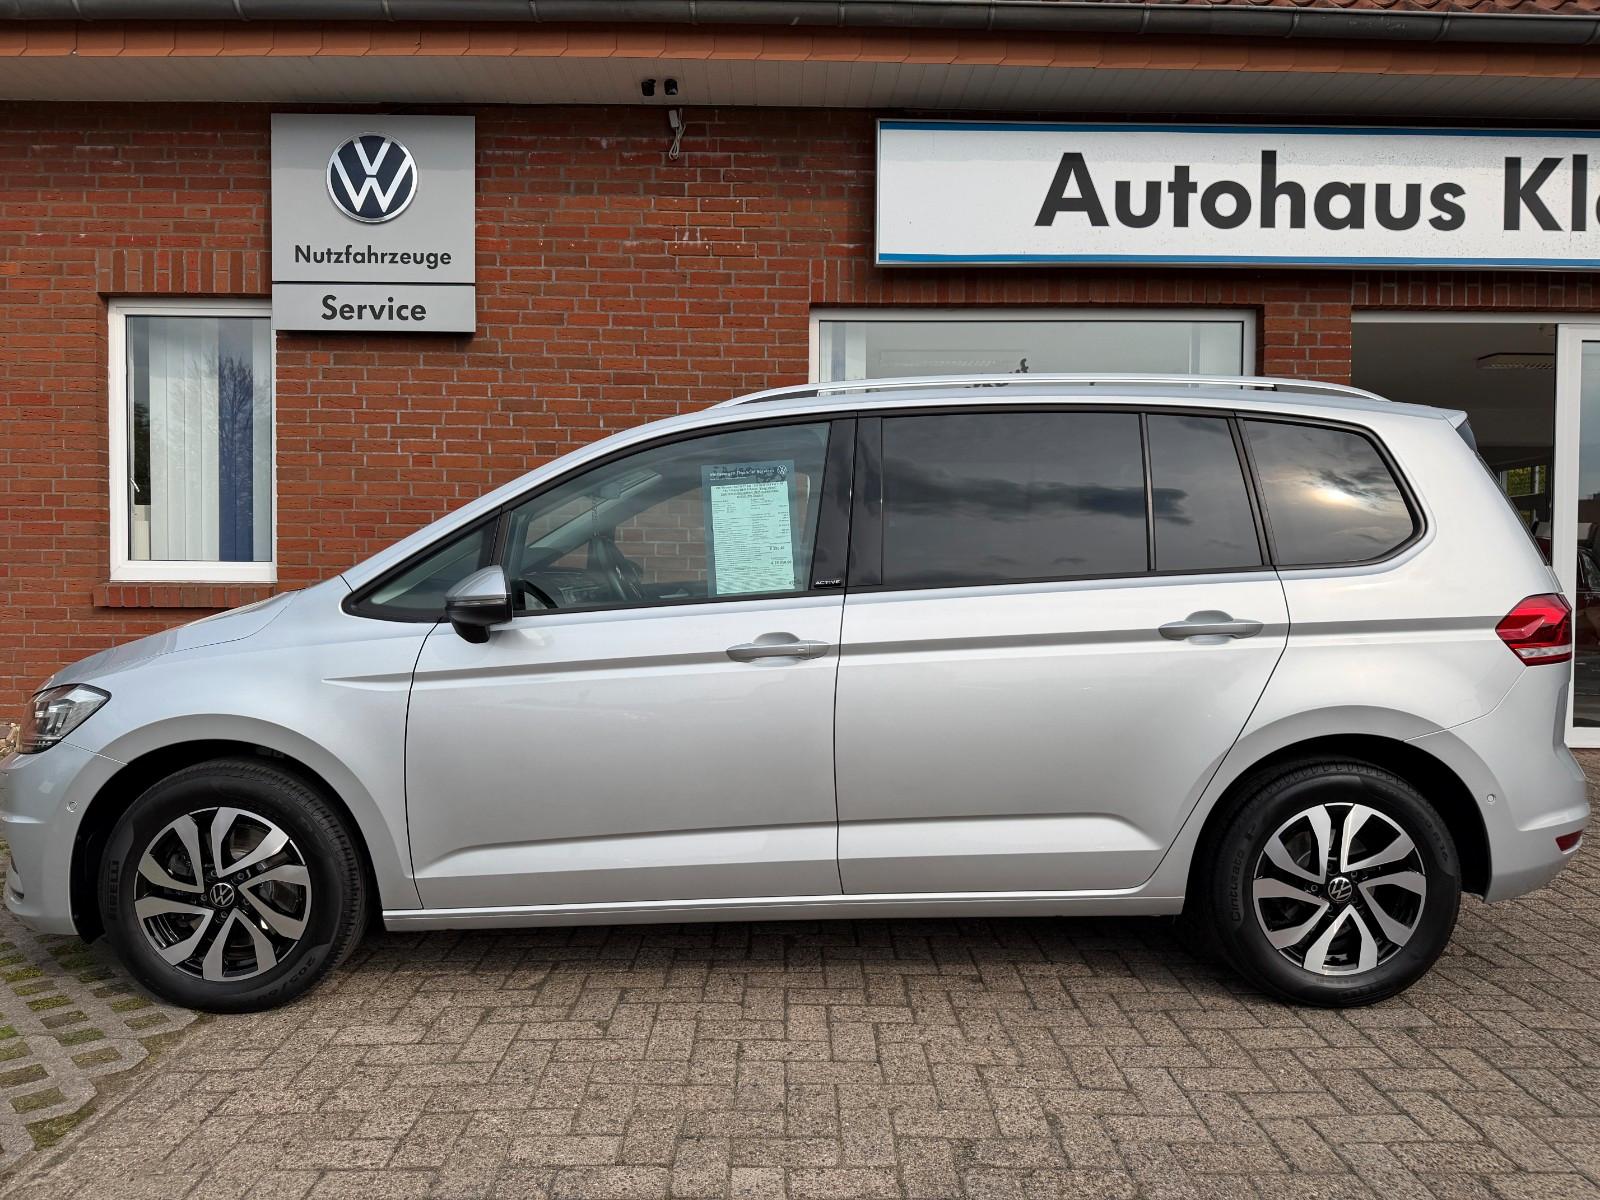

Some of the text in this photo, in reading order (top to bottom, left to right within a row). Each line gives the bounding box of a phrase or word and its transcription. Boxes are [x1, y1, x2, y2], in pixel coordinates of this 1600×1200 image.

[327, 132, 418, 222] VW
[1034, 150, 1600, 232] Autohaus Kl
[294, 244, 452, 270] Nutzfahrzeuge
[321, 294, 427, 321] Service
